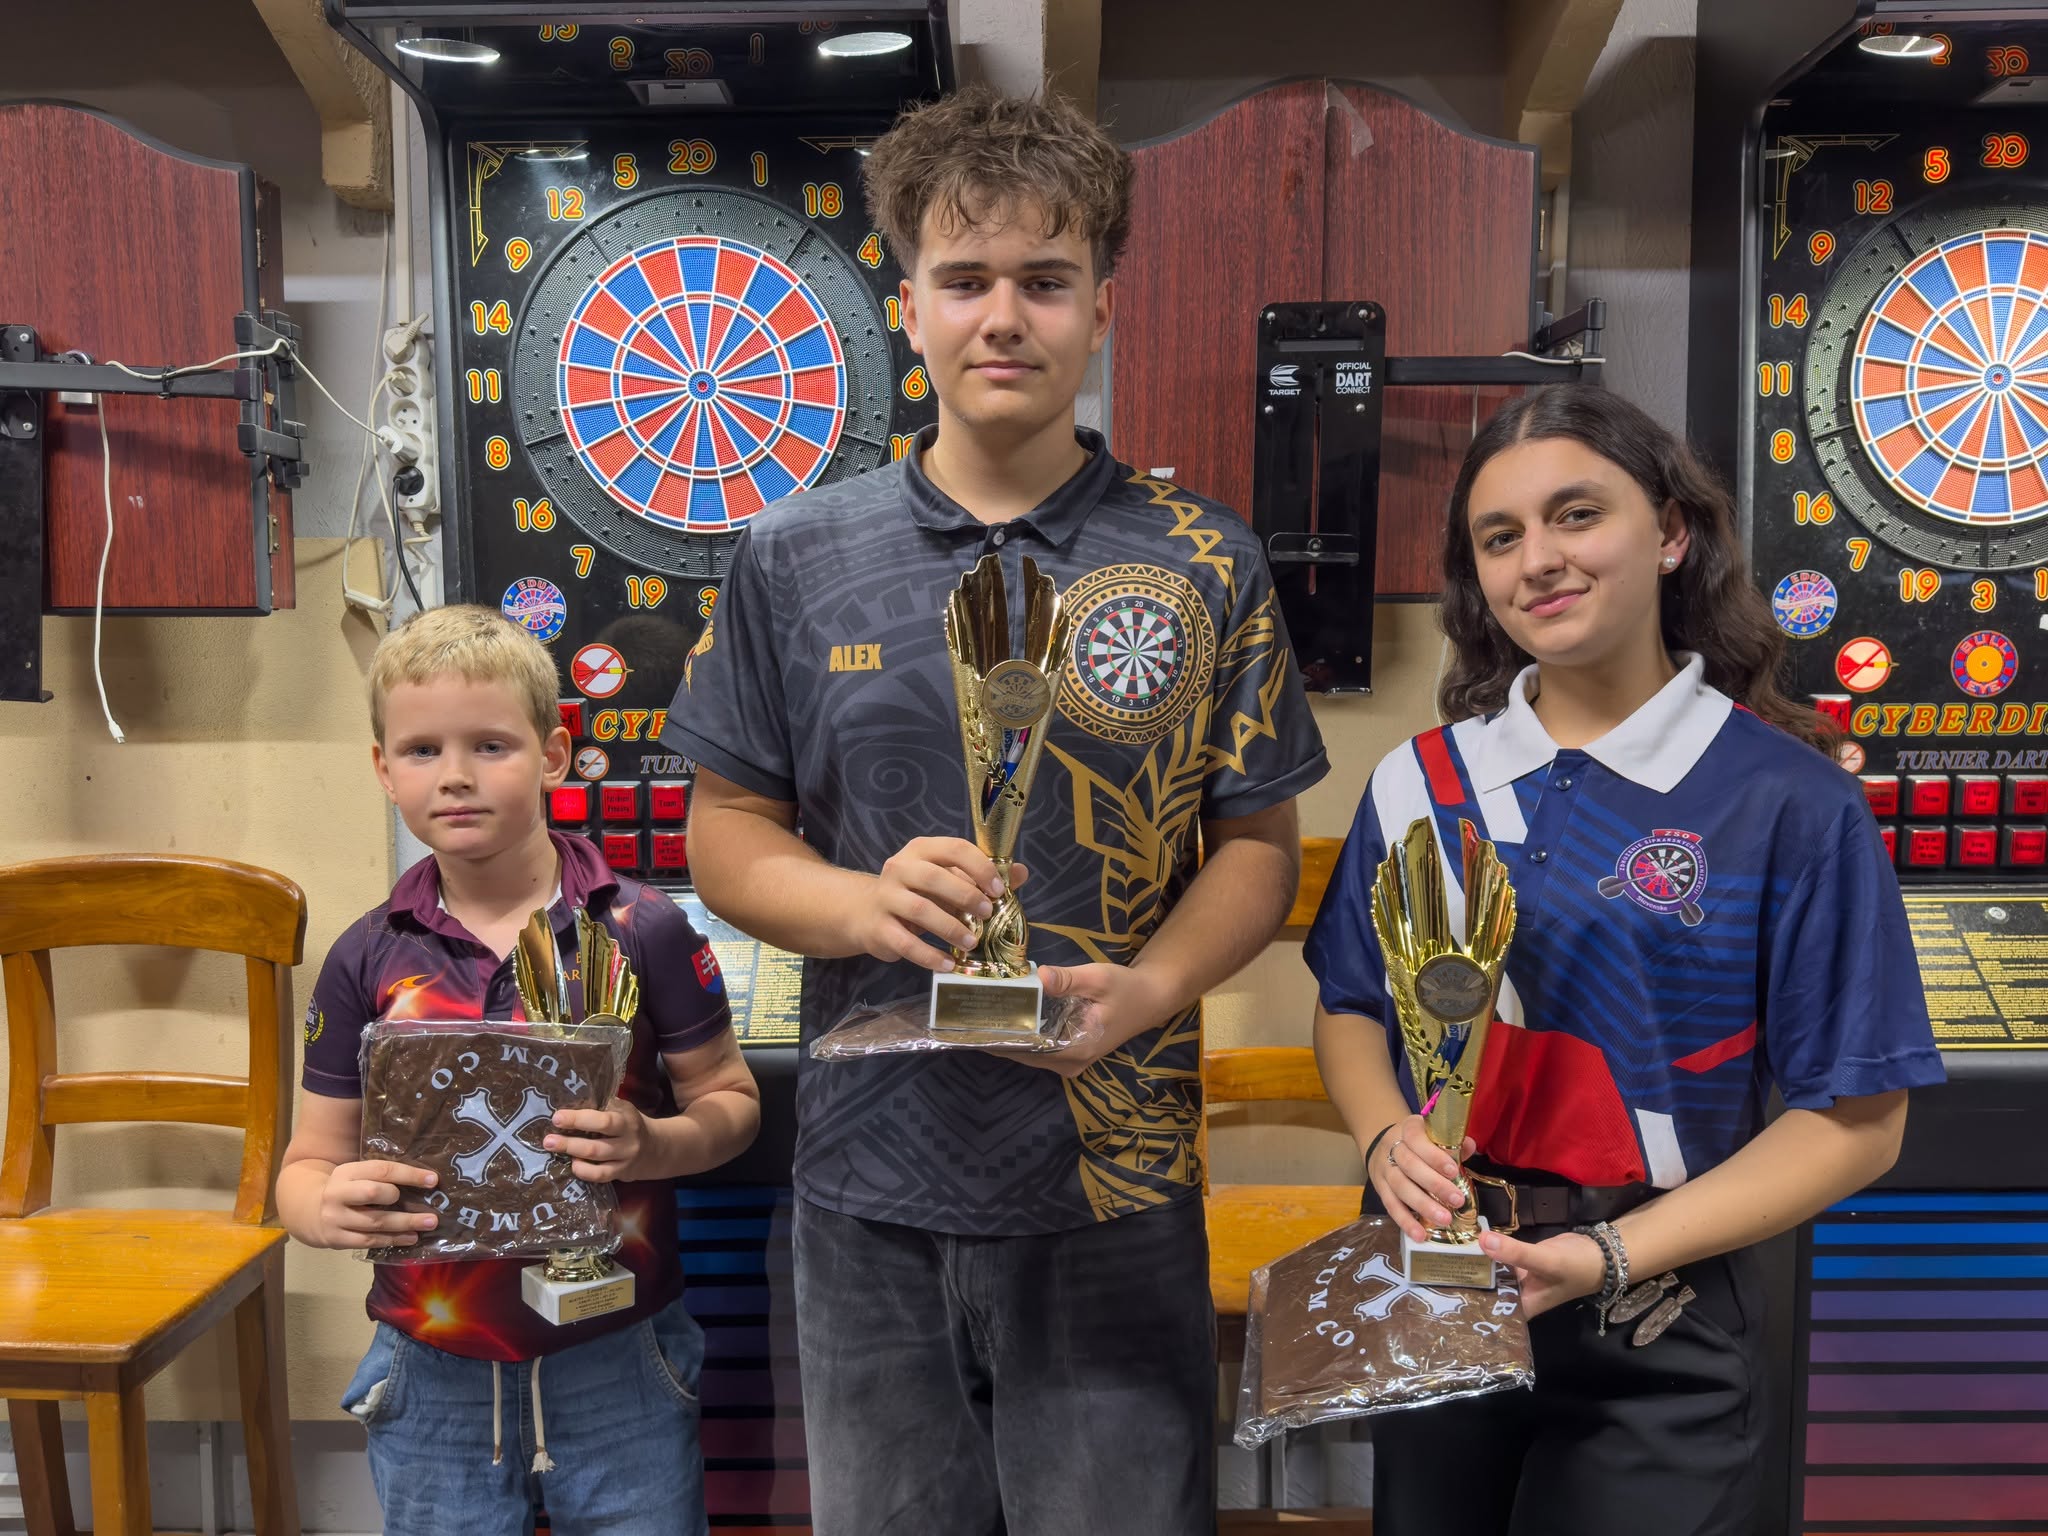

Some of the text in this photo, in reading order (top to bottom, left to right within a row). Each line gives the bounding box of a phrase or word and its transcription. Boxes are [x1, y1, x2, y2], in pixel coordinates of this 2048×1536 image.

[668, 139, 717, 174] 20
[1924, 147, 1950, 183] 5
[1980, 132, 2029, 168] 20
[613, 153, 639, 189] 5
[751, 151, 768, 186] 1
[547, 186, 586, 221] 12
[803, 183, 843, 218] 18
[1853, 179, 1894, 214] 12
[505, 237, 532, 271] 9
[857, 232, 883, 268] 4
[1808, 230, 1836, 265] 9
[470, 300, 513, 335] 14
[884, 296, 905, 331] 1
[1768, 294, 1810, 328] 14
[902, 365, 929, 401] 6
[1336, 362, 1372, 370] OFFICIAL
[1336, 372, 1372, 387] DART
[1759, 362, 1793, 396] 11
[466, 368, 502, 403] 11
[1268, 388, 1302, 396] TARGET
[1335, 386, 1371, 394] CONNECT
[485, 436, 510, 470] 8
[1770, 429, 1796, 463] 8
[513, 498, 556, 532] 16
[1793, 491, 1836, 525] 16
[570, 545, 595, 578] 7
[1846, 537, 1872, 572] 7
[517, 579, 547, 591] EDU
[626, 575, 668, 608] 19
[1790, 572, 1820, 583] EDU
[1899, 568, 1941, 602] 19
[1134, 600, 1144, 608] 20
[1970, 579, 1996, 613] 3
[829, 644, 882, 673] ALEX
[1960, 633, 2008, 655] BULL
[1111, 694, 1121, 703] 19
[1967, 680, 2001, 695] EYE
[1852, 702, 2048, 737] CYBERDI
[640, 755, 698, 775] TURN
[1896, 750, 1988, 770] TURNIER
[501, 1044, 588, 1096] RUM
[423, 1180, 588, 1232] BUMBU
[1308, 1247, 1355, 1312] RUM
